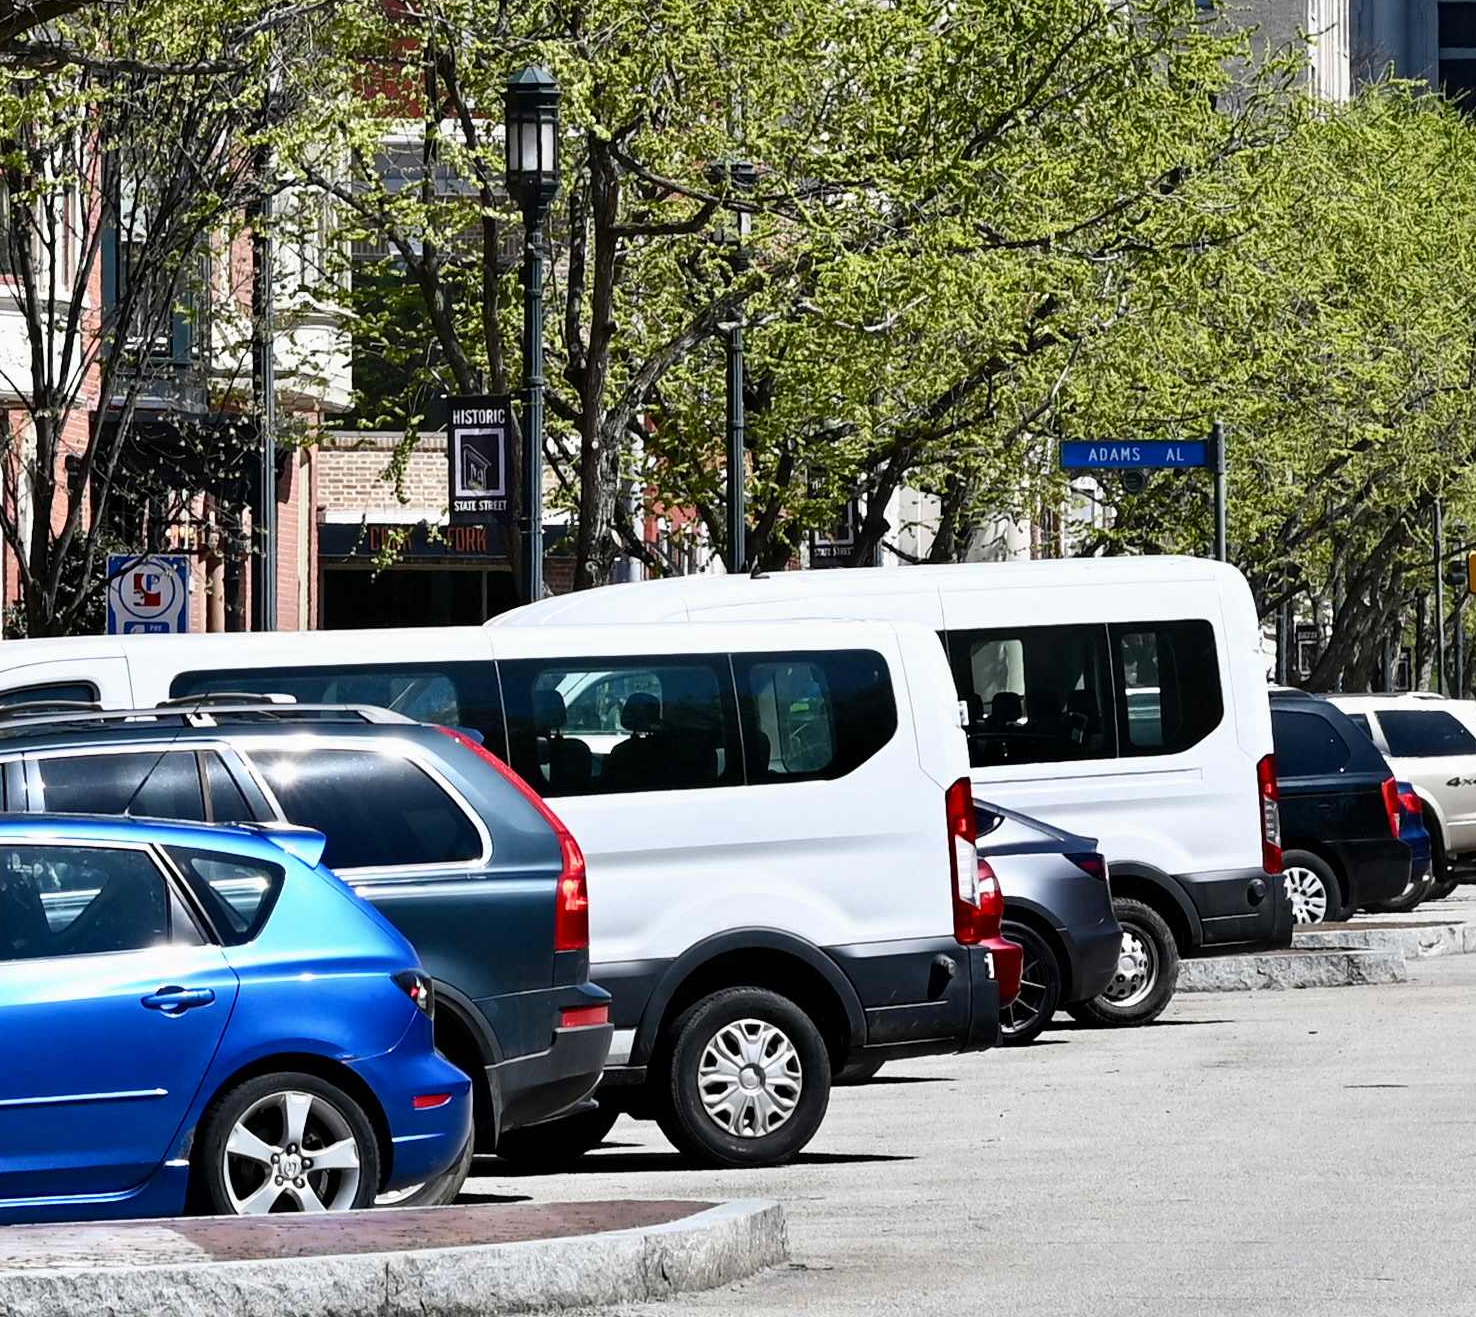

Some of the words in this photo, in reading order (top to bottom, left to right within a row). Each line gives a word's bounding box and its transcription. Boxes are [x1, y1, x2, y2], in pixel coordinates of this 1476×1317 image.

[452, 408, 506, 425] HISTORIC
[1088, 447, 1141, 462] ADAMS
[1165, 447, 1185, 462] AL
[454, 500, 477, 512] STATE
[478, 500, 507, 511] STREET
